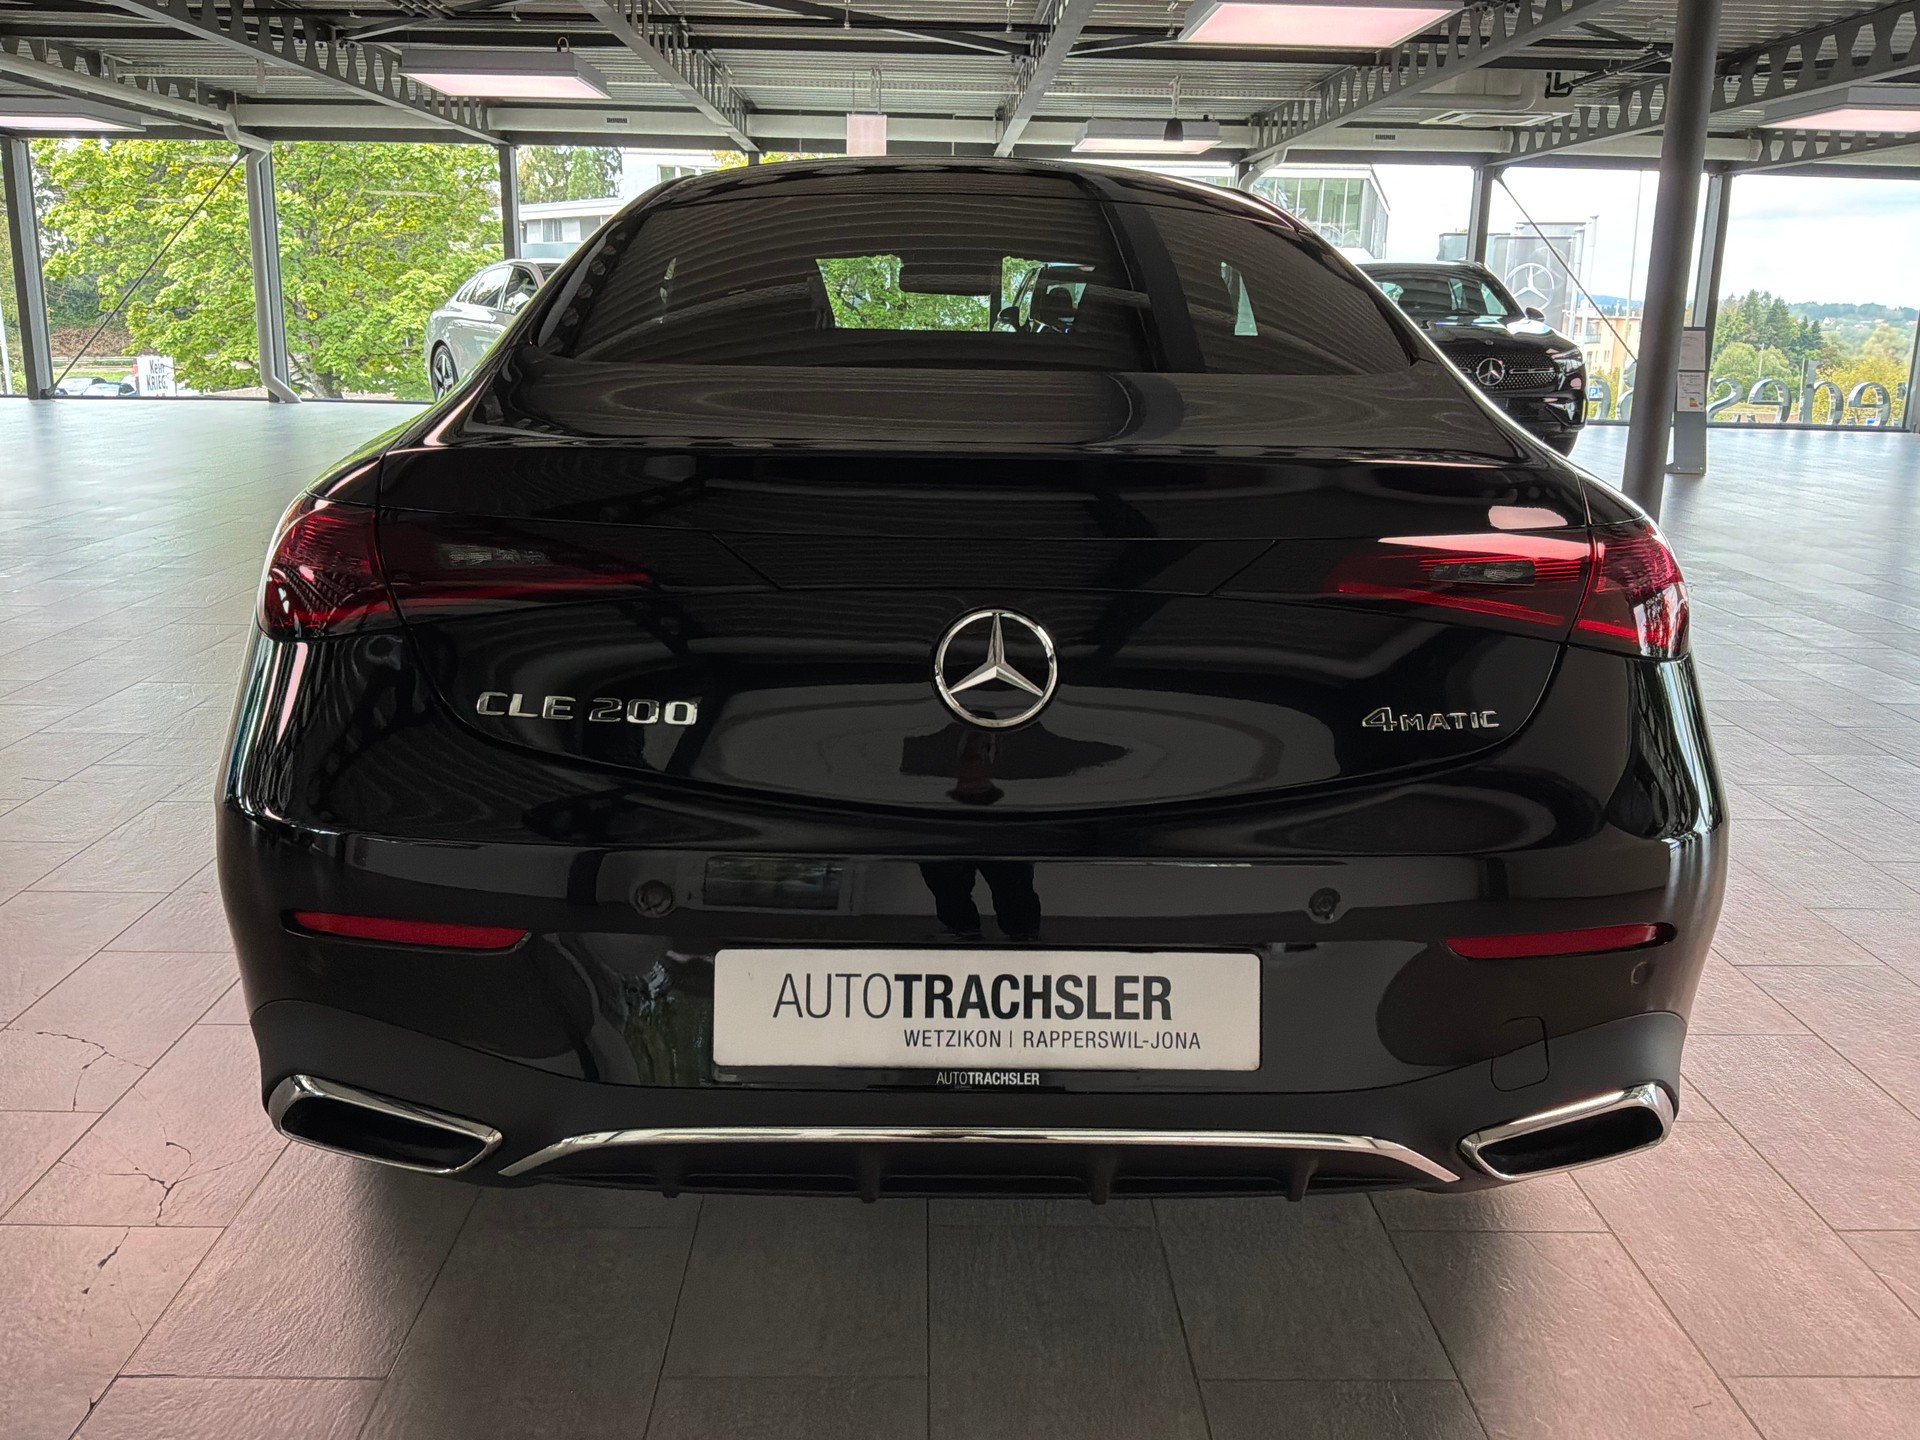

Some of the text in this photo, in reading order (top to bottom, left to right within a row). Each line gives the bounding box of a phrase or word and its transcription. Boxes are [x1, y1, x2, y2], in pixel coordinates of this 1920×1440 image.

[476, 691, 699, 726] CLE 200
[1361, 706, 1500, 732] 4MATIC
[772, 973, 1173, 1021] AUTOTRACHSLER
[903, 1029, 1001, 1048] WETZIKON
[1023, 1030, 1201, 1050] RAPPERSWIL-JONA
[935, 1071, 1041, 1086] AUTOTRACHSLER
